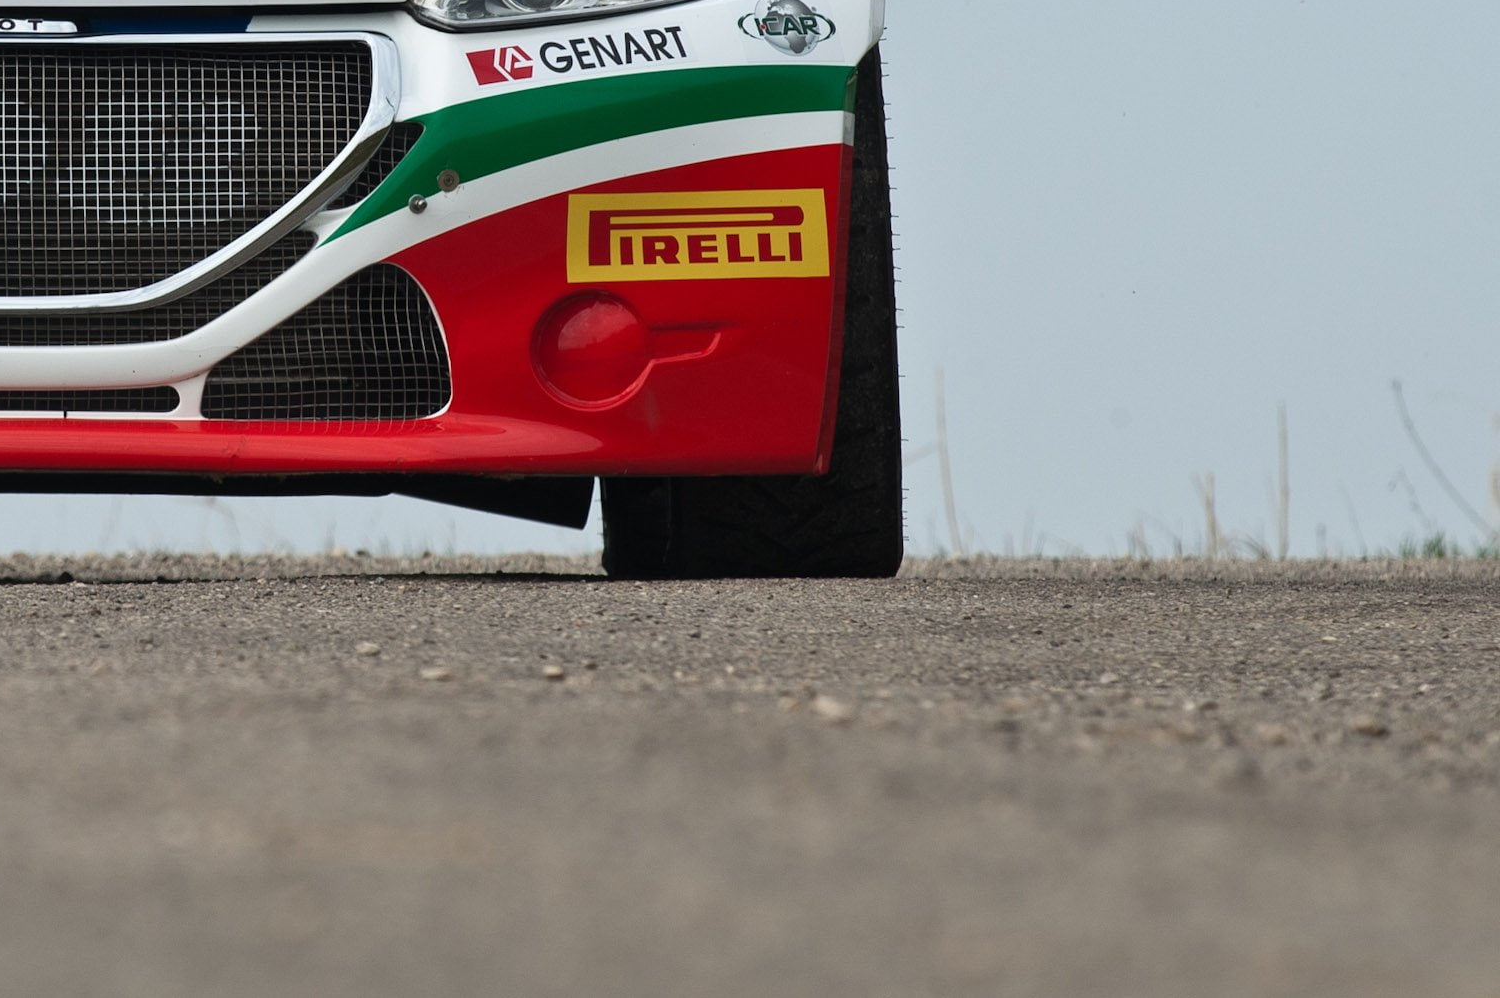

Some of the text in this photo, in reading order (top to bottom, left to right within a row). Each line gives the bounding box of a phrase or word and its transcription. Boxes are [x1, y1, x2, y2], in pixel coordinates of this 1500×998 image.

[539, 26, 687, 73] GENART
[754, 16, 821, 36] ICAR
[588, 205, 804, 266] PIRELLI
